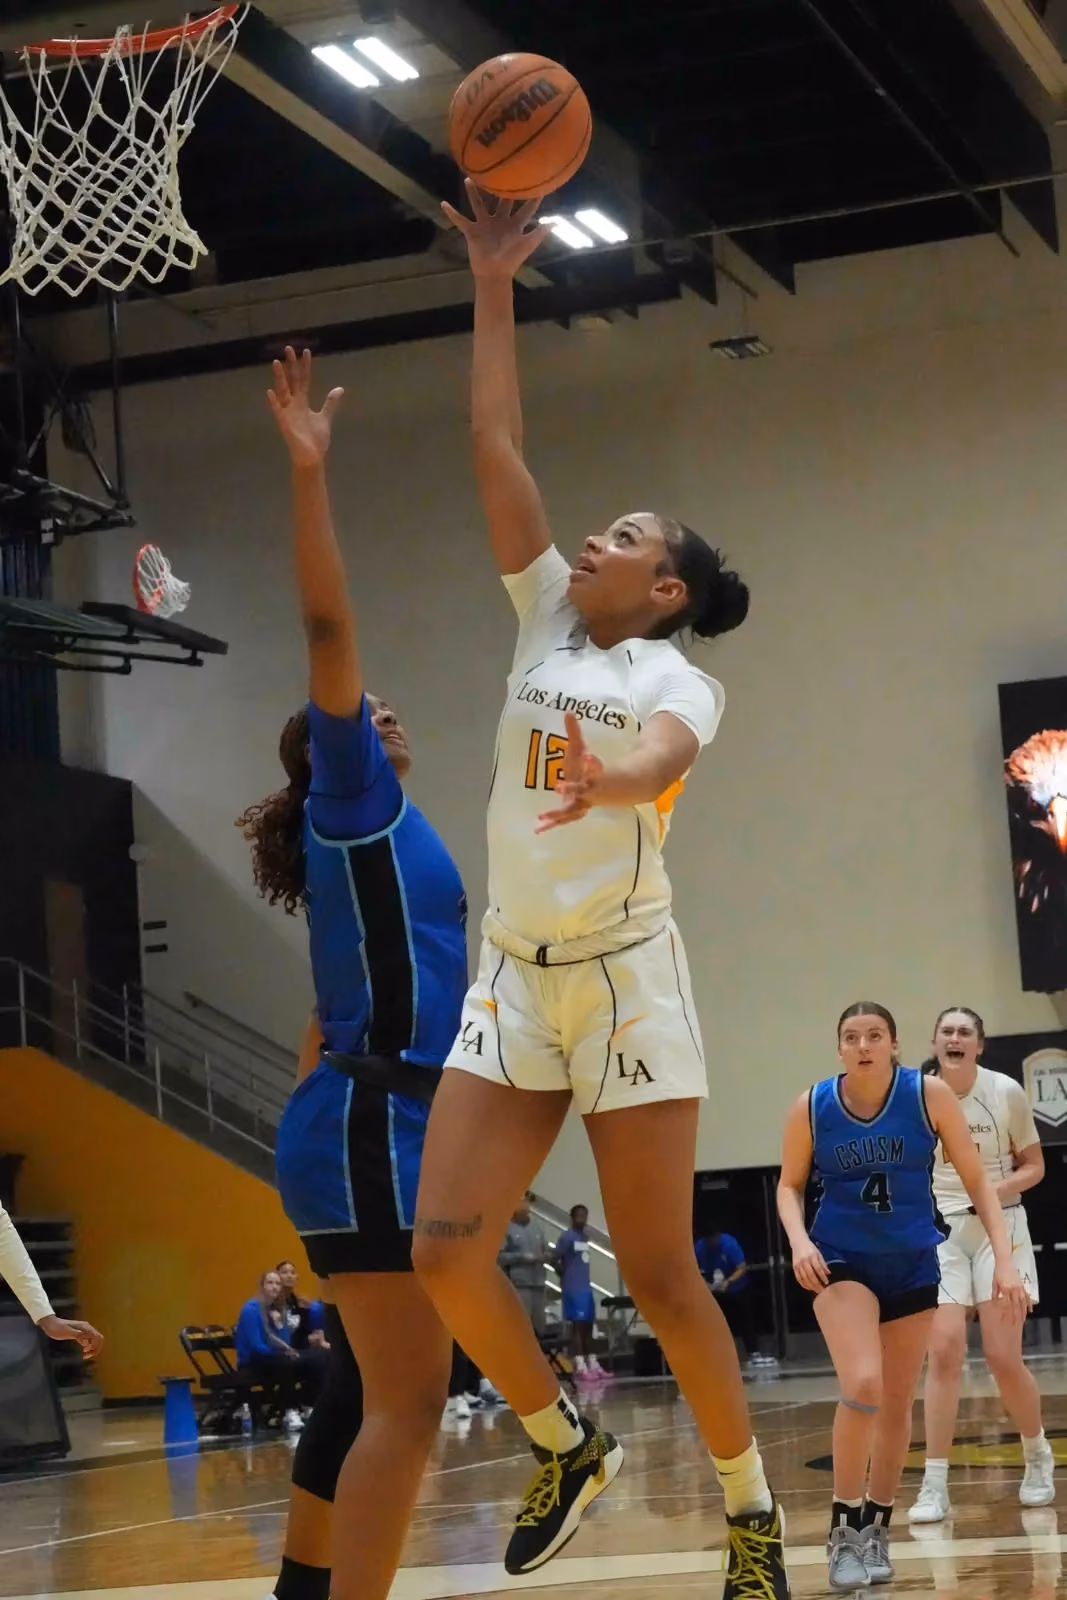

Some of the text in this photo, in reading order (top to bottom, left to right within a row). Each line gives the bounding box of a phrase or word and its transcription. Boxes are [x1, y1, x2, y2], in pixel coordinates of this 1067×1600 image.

[517, 682, 627, 730] Los Angeles
[525, 728, 569, 791] 12
[461, 1020, 484, 1057] LA
[615, 1052, 656, 1086] LA
[833, 1135, 905, 1172] CSUSM
[860, 1171, 893, 1214] 4
